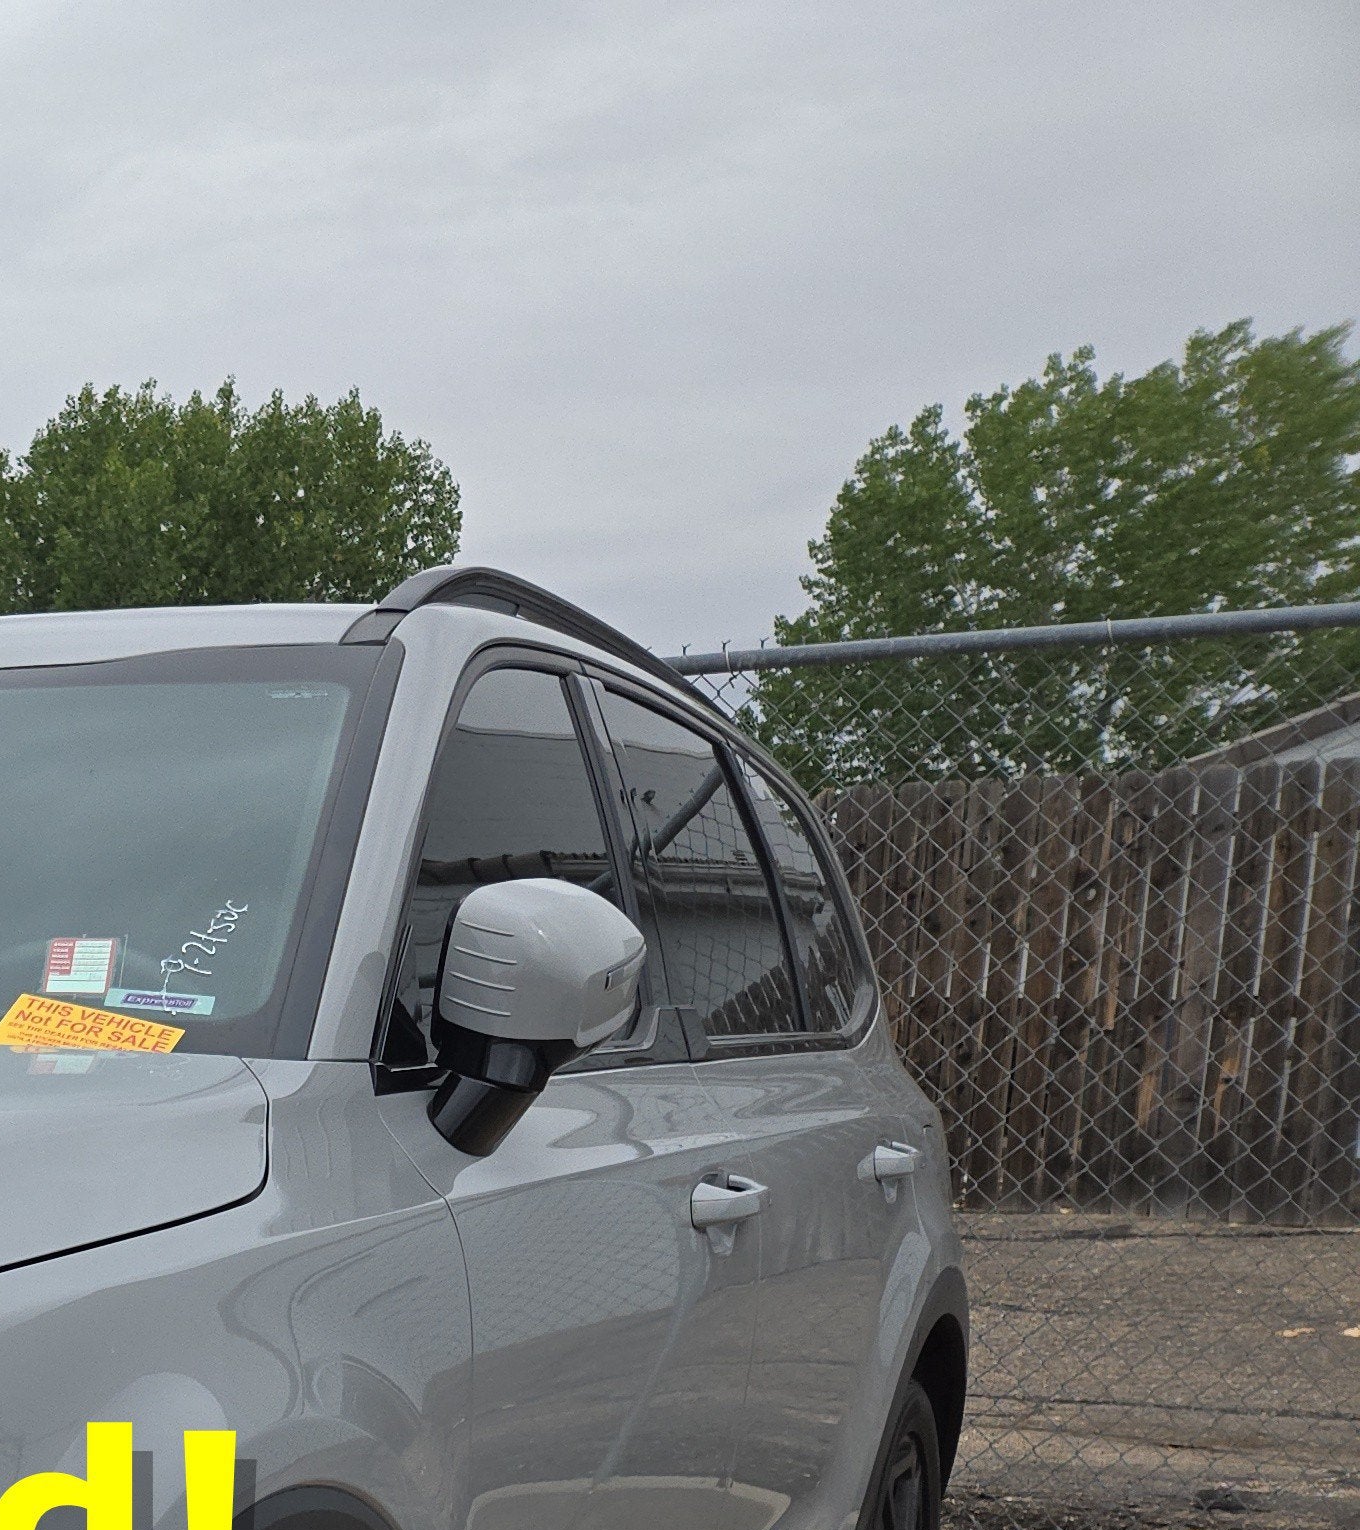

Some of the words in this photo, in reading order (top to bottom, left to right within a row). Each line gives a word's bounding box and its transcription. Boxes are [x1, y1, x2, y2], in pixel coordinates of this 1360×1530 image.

[15, 1009, 52, 1027] Not
[55, 1018, 103, 1038] FOR
[107, 1030, 170, 1054] SALE
[27, 998, 74, 1017] THIS
[80, 1009, 175, 1042] VEHICLE
